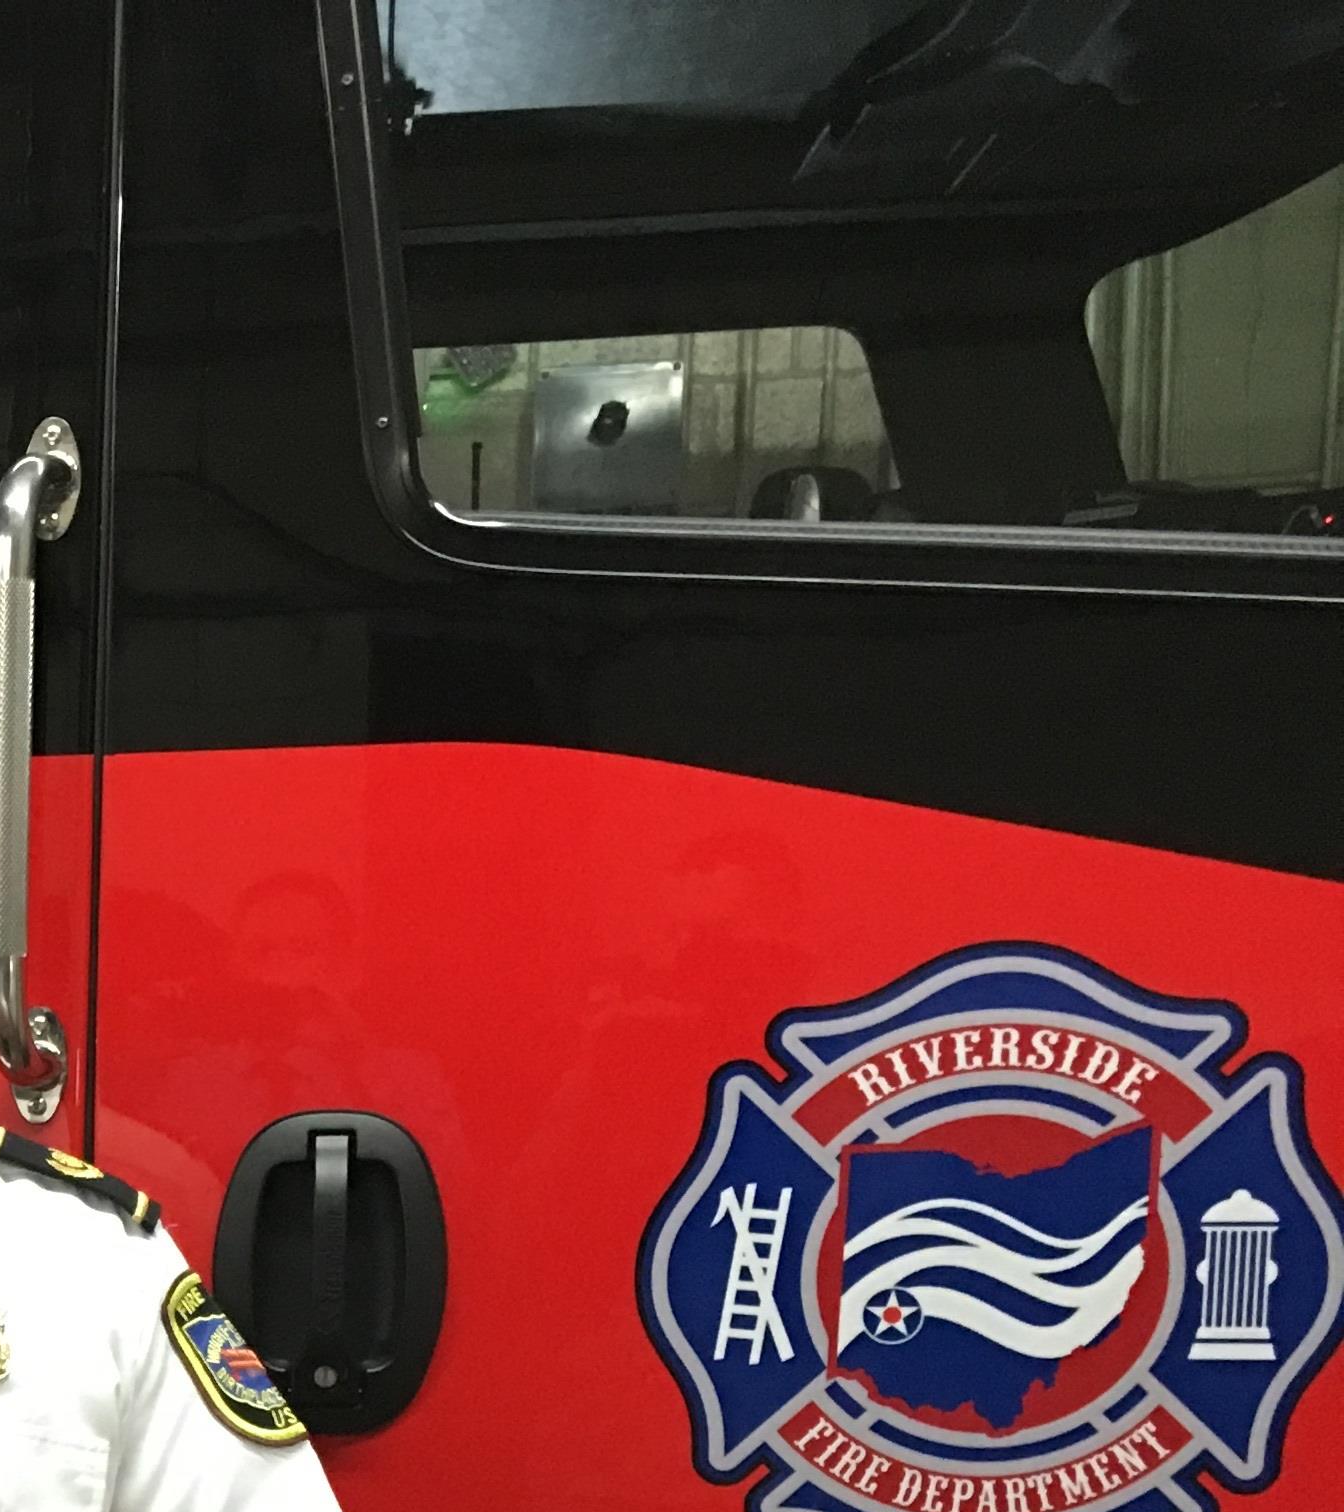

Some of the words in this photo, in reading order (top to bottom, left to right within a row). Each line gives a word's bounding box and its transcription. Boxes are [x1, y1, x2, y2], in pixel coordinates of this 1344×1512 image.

[847, 1026, 1160, 1107] RIVERSIDE
[176, 1286, 206, 1322] FIRE
[792, 1415, 894, 1497] FIRE
